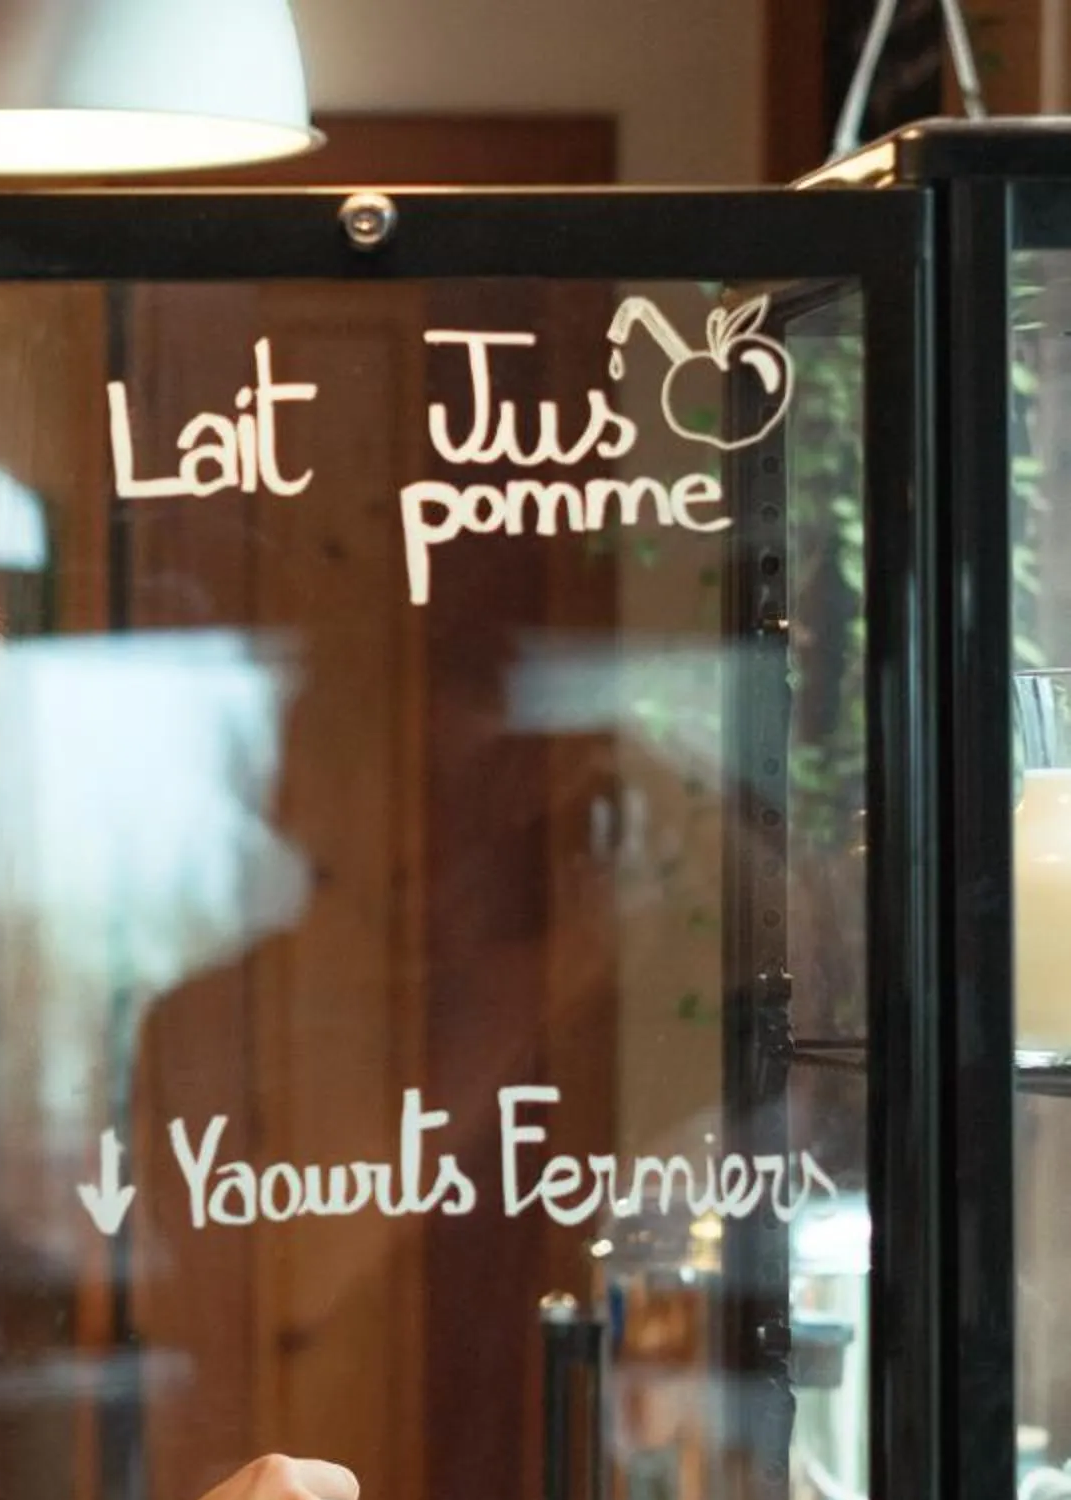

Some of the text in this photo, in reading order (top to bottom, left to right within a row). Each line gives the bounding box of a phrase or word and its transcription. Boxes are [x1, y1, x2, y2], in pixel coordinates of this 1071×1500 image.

[107, 338, 317, 499] Lait
[423, 330, 637, 465] Jus
[401, 474, 732, 605] pomme
[169, 1086, 841, 1228] Yaourts Fermiers
